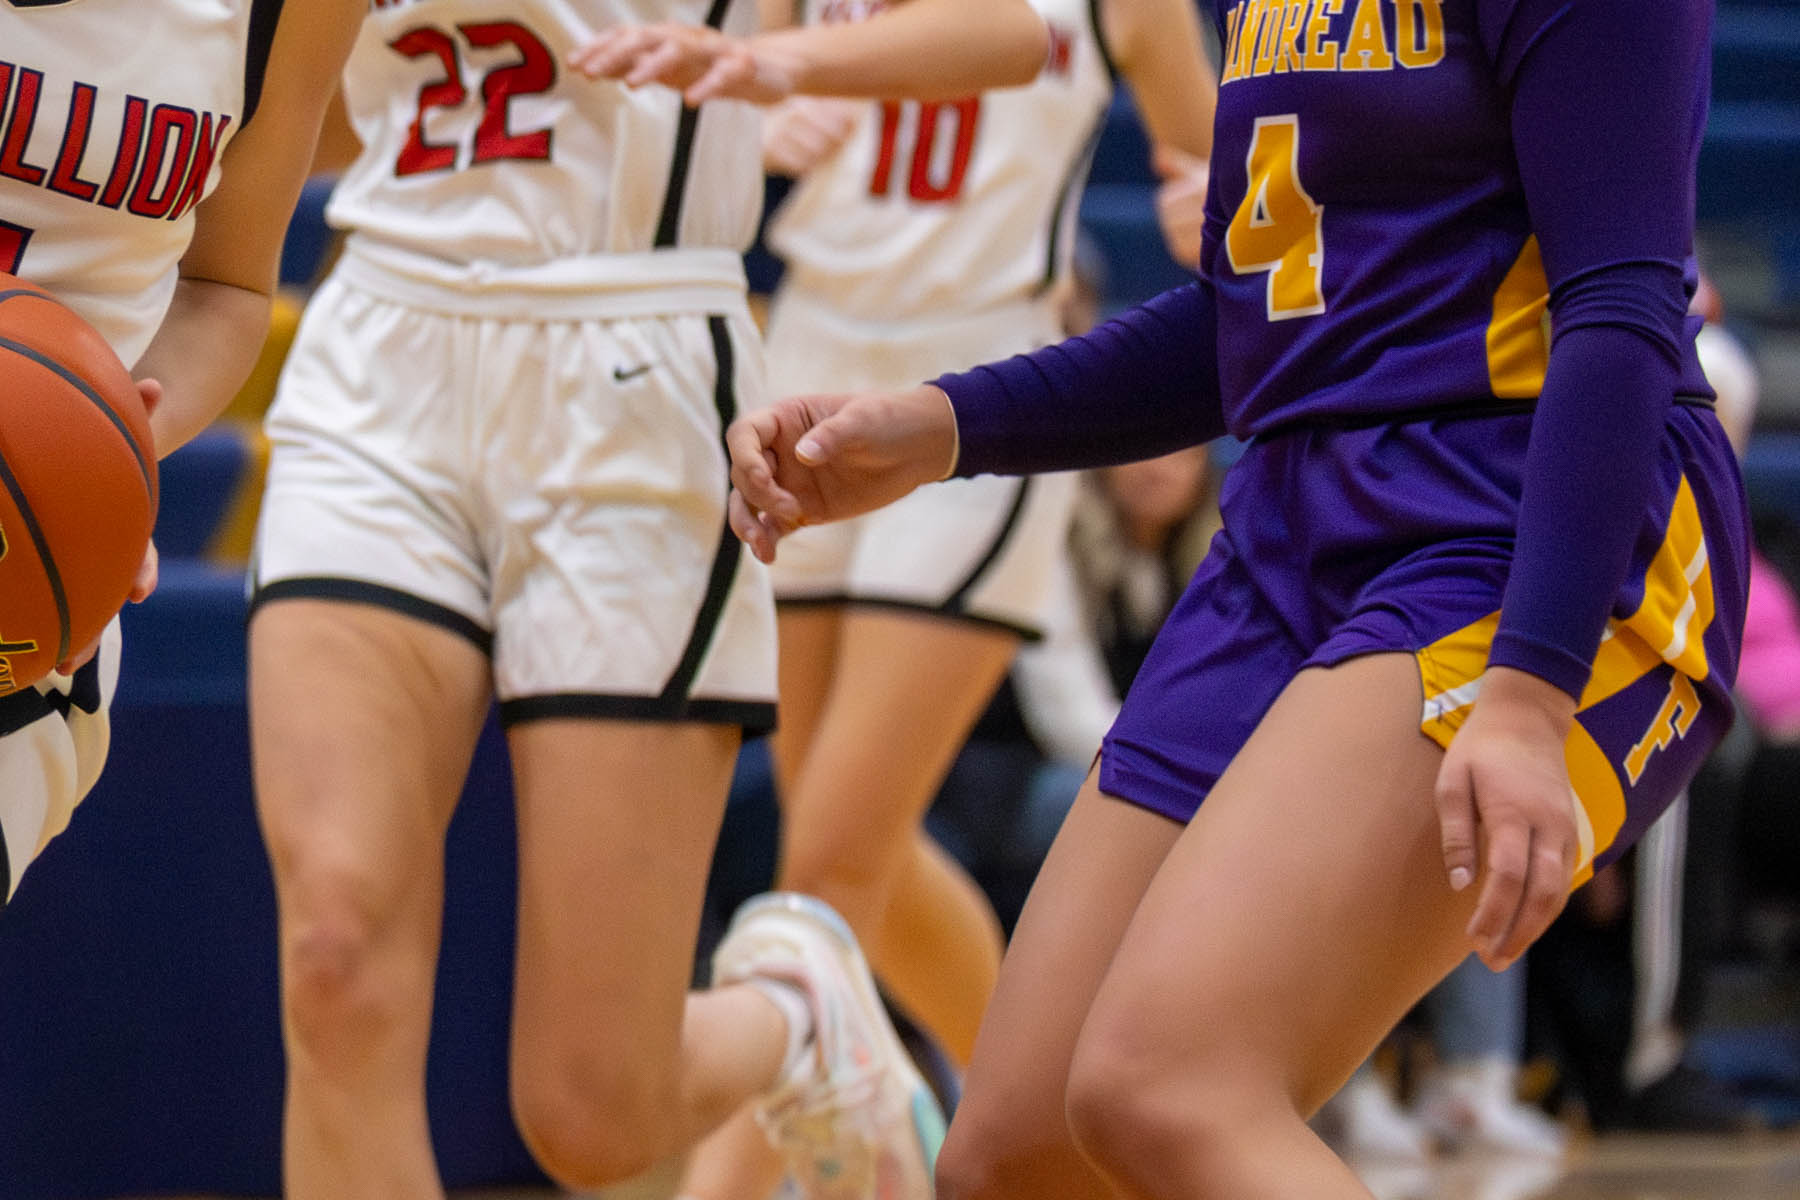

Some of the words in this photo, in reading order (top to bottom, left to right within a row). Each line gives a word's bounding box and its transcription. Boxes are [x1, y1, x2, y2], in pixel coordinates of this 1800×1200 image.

[386, 22, 557, 179] 22
[1225, 113, 1326, 322] 4
[1623, 670, 1702, 788] F
